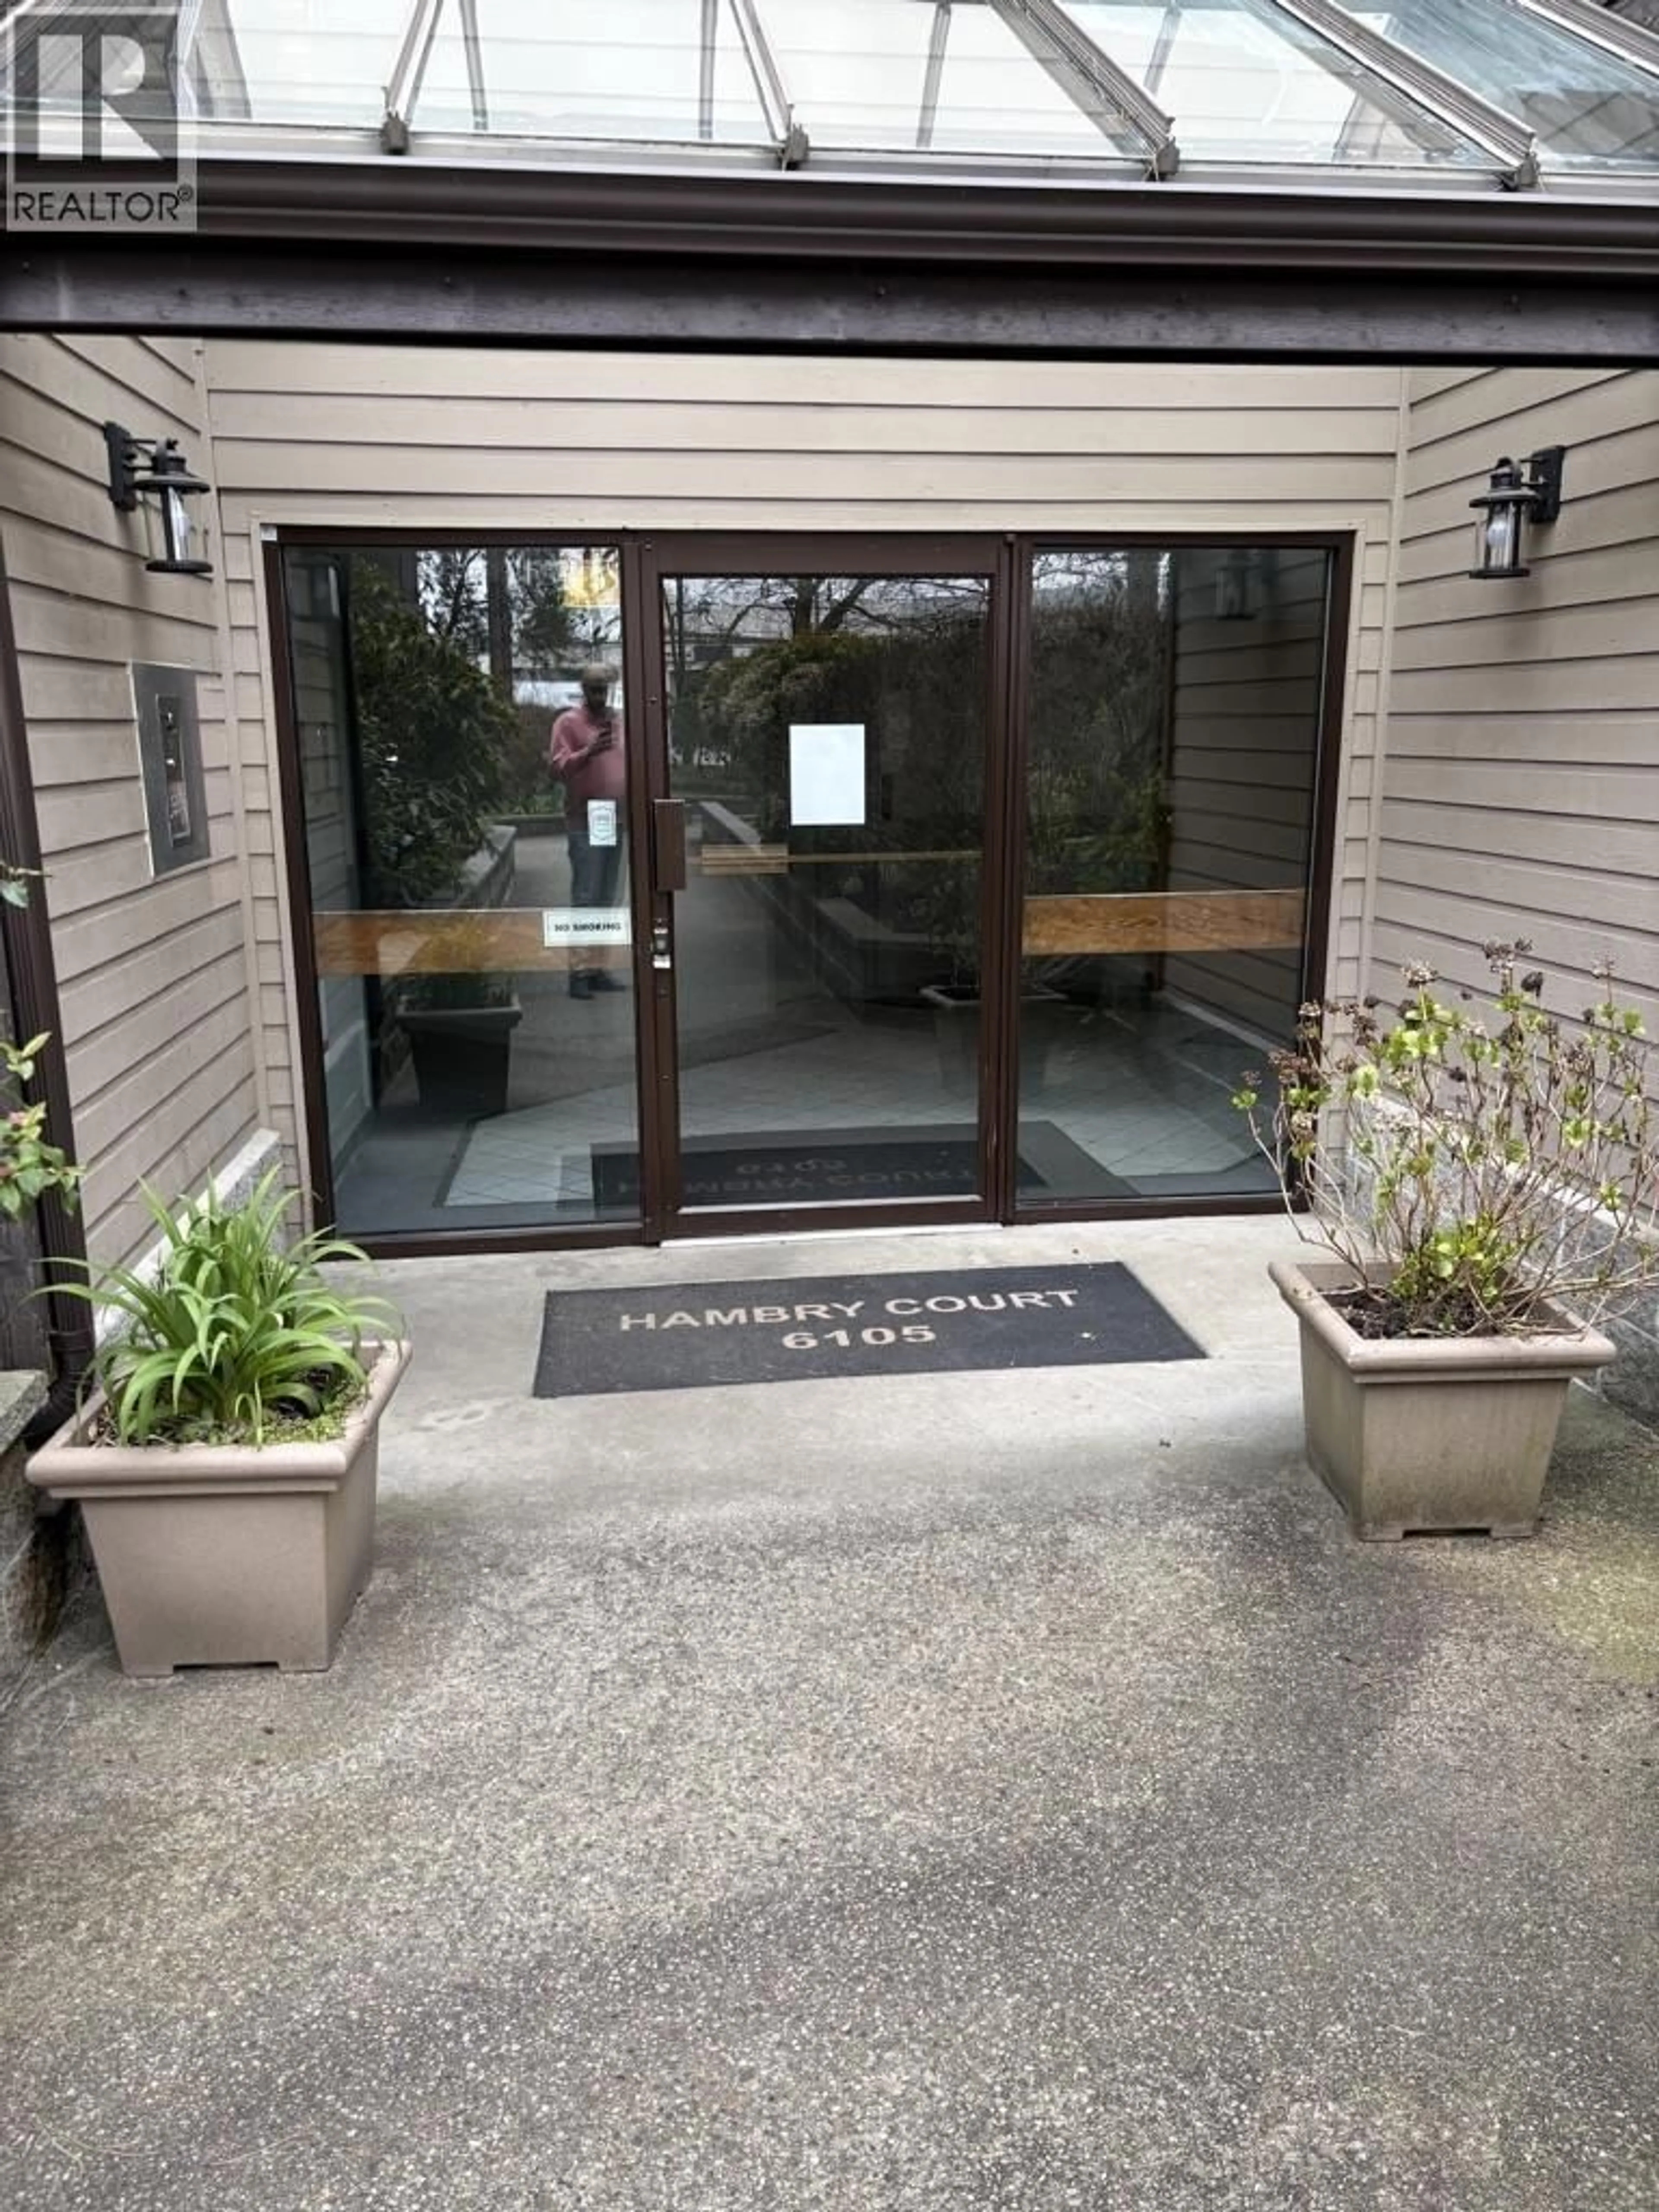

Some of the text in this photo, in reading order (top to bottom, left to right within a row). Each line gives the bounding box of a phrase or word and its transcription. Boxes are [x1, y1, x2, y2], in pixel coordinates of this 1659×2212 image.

[572, 922, 622, 932] SMOKING
[620, 1289, 1078, 1331] HAMBRY COURT
[782, 1325, 936, 1350] 6105
